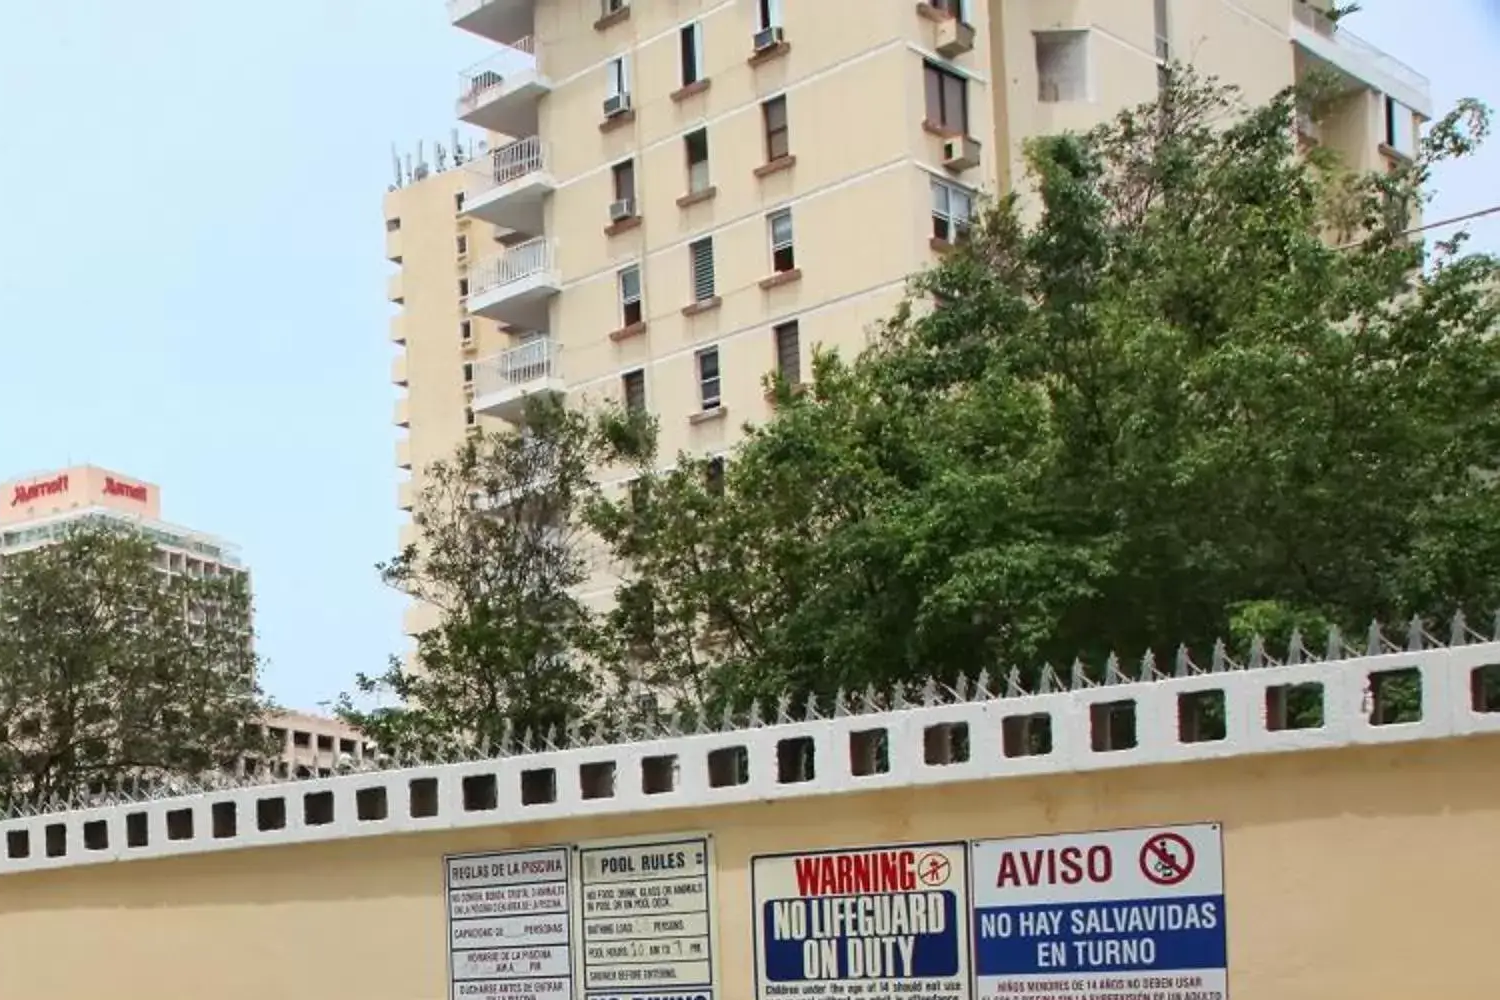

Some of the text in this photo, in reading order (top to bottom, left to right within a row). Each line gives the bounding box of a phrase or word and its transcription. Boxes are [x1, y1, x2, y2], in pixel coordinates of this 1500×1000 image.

[452, 859, 563, 880] REGLAS DE LA PISCINA
[601, 851, 685, 875] POOL RULES
[795, 851, 917, 897] WARNING
[997, 845, 1113, 887] AVISO
[773, 892, 946, 941] NO LIFEGUARD
[981, 902, 1218, 939] NO HAY SALVAVIDAS
[804, 936, 915, 980] ON DUTY
[1037, 938, 1157, 968] EN TURNO
[766, 984, 799, 995] Children
[802, 984, 826, 995] under
[830, 983, 844, 993] the
[847, 985, 862, 995] age
[867, 982, 877, 993] of
[894, 981, 921, 993] should
[926, 981, 940, 992] not
[944, 982, 961, 991] use
[1028, 980, 1070, 991] MENORES
[1072, 979, 1084, 990] DE
[1087, 979, 1097, 989] 14
[1127, 979, 1140, 989] NO
[1143, 977, 1173, 988] DEBEN
[1176, 976, 1202, 988] USAR
